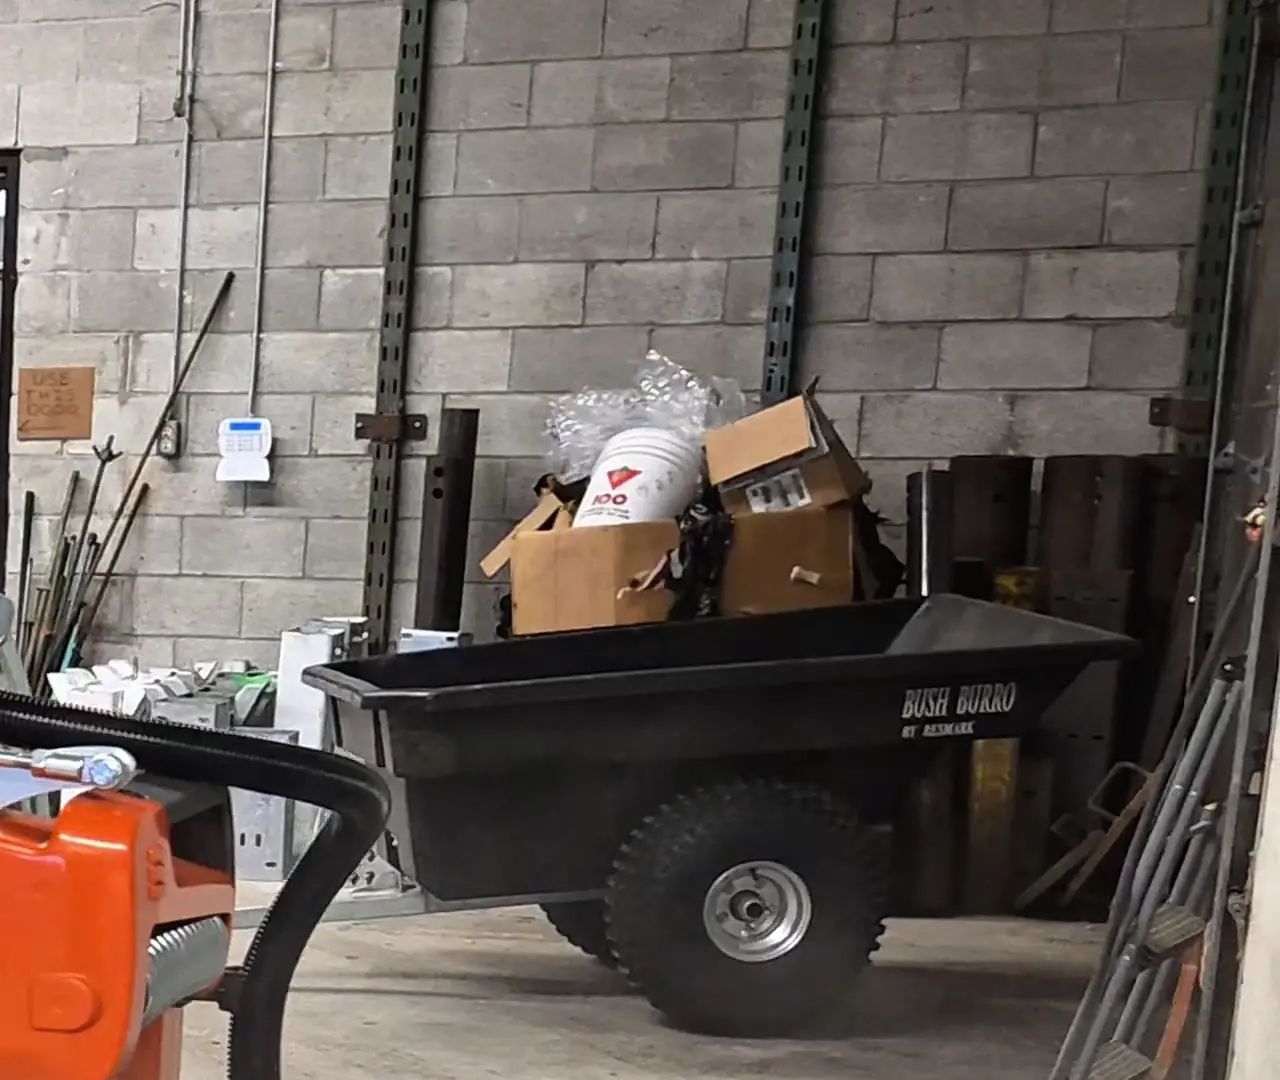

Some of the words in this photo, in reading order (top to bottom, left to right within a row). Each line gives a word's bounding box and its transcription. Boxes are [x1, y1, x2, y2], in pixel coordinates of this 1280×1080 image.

[592, 493, 628, 506] 100
[901, 687, 950, 719] BUSH
[956, 682, 1016, 714] BURRO
